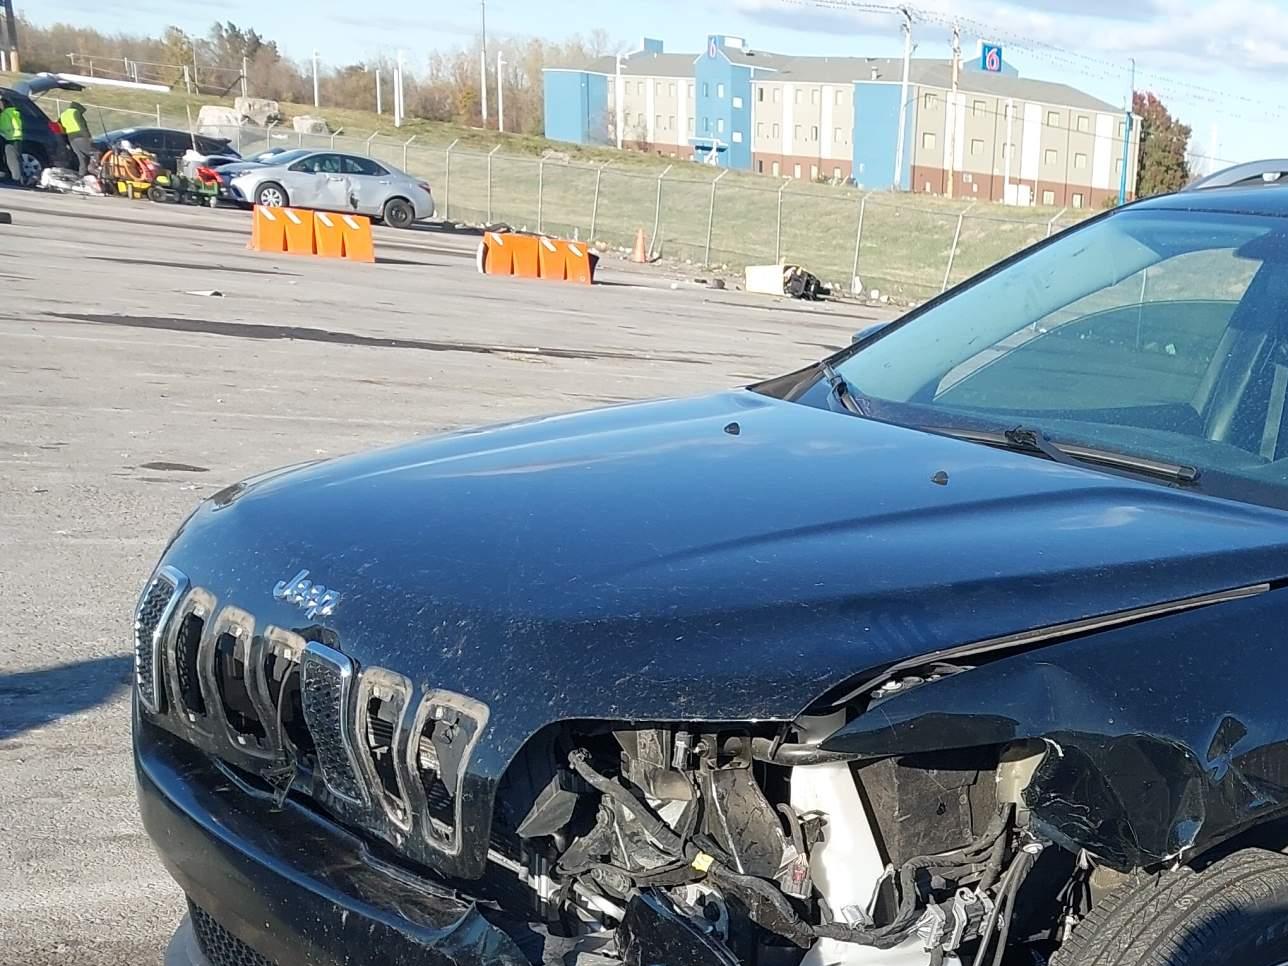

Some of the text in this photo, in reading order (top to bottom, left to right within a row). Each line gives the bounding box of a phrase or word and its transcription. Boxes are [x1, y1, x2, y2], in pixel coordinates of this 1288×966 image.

[709, 37, 716, 57] 6
[985, 47, 1000, 71] 6
[273, 569, 341, 620] Jeep
